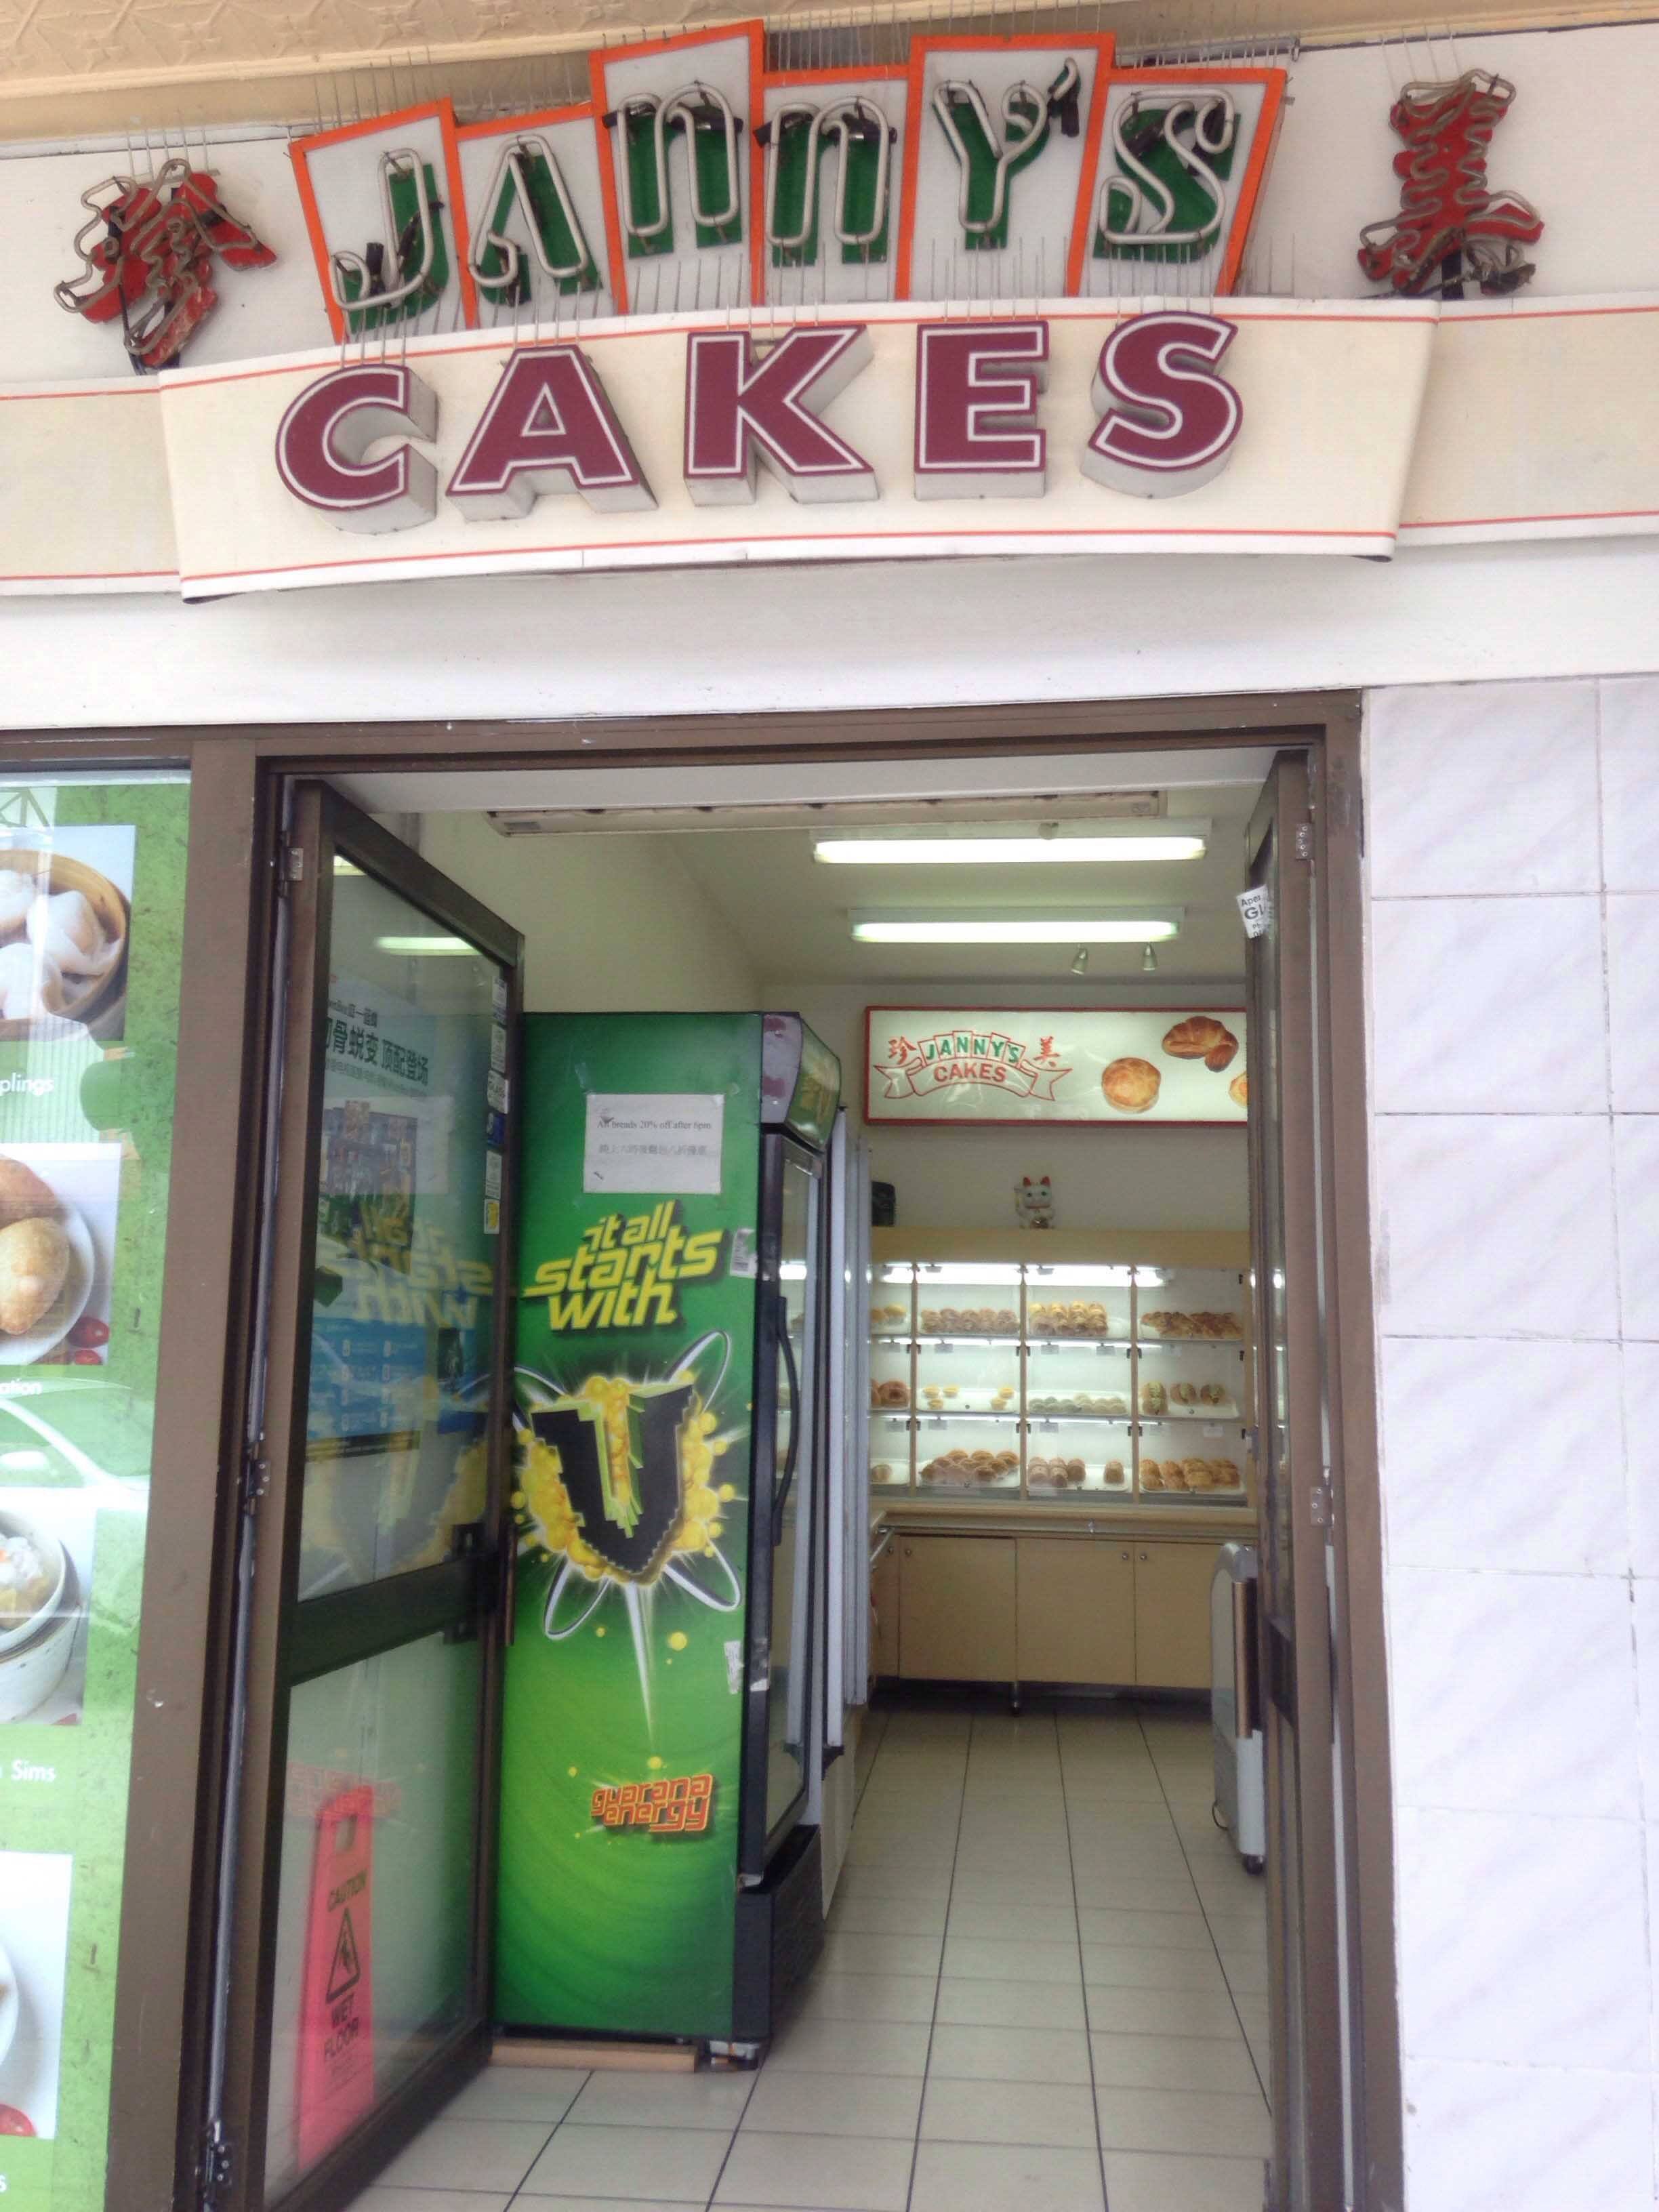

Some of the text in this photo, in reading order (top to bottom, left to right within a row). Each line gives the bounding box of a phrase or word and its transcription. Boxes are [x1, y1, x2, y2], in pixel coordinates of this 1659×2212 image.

[275, 311, 1243, 516] CAKES
[888, 1036, 917, 1065] 珍
[926, 1036, 1020, 1063] JANNY'S
[933, 1063, 1007, 1082] CAKES
[640, 1120, 657, 1129] 20%
[659, 1120, 673, 1129] off
[673, 1120, 691, 1129] after
[584, 1200, 676, 1252] it all
[523, 1225, 724, 1297] starts
[548, 1267, 677, 1330] with
[12, 1759, 56, 1782] Sims
[591, 1774, 713, 1816] guarana
[602, 1796, 710, 1832] energy
[331, 1992, 354, 2028] WET
[325, 2015, 360, 2063] FLOOR
